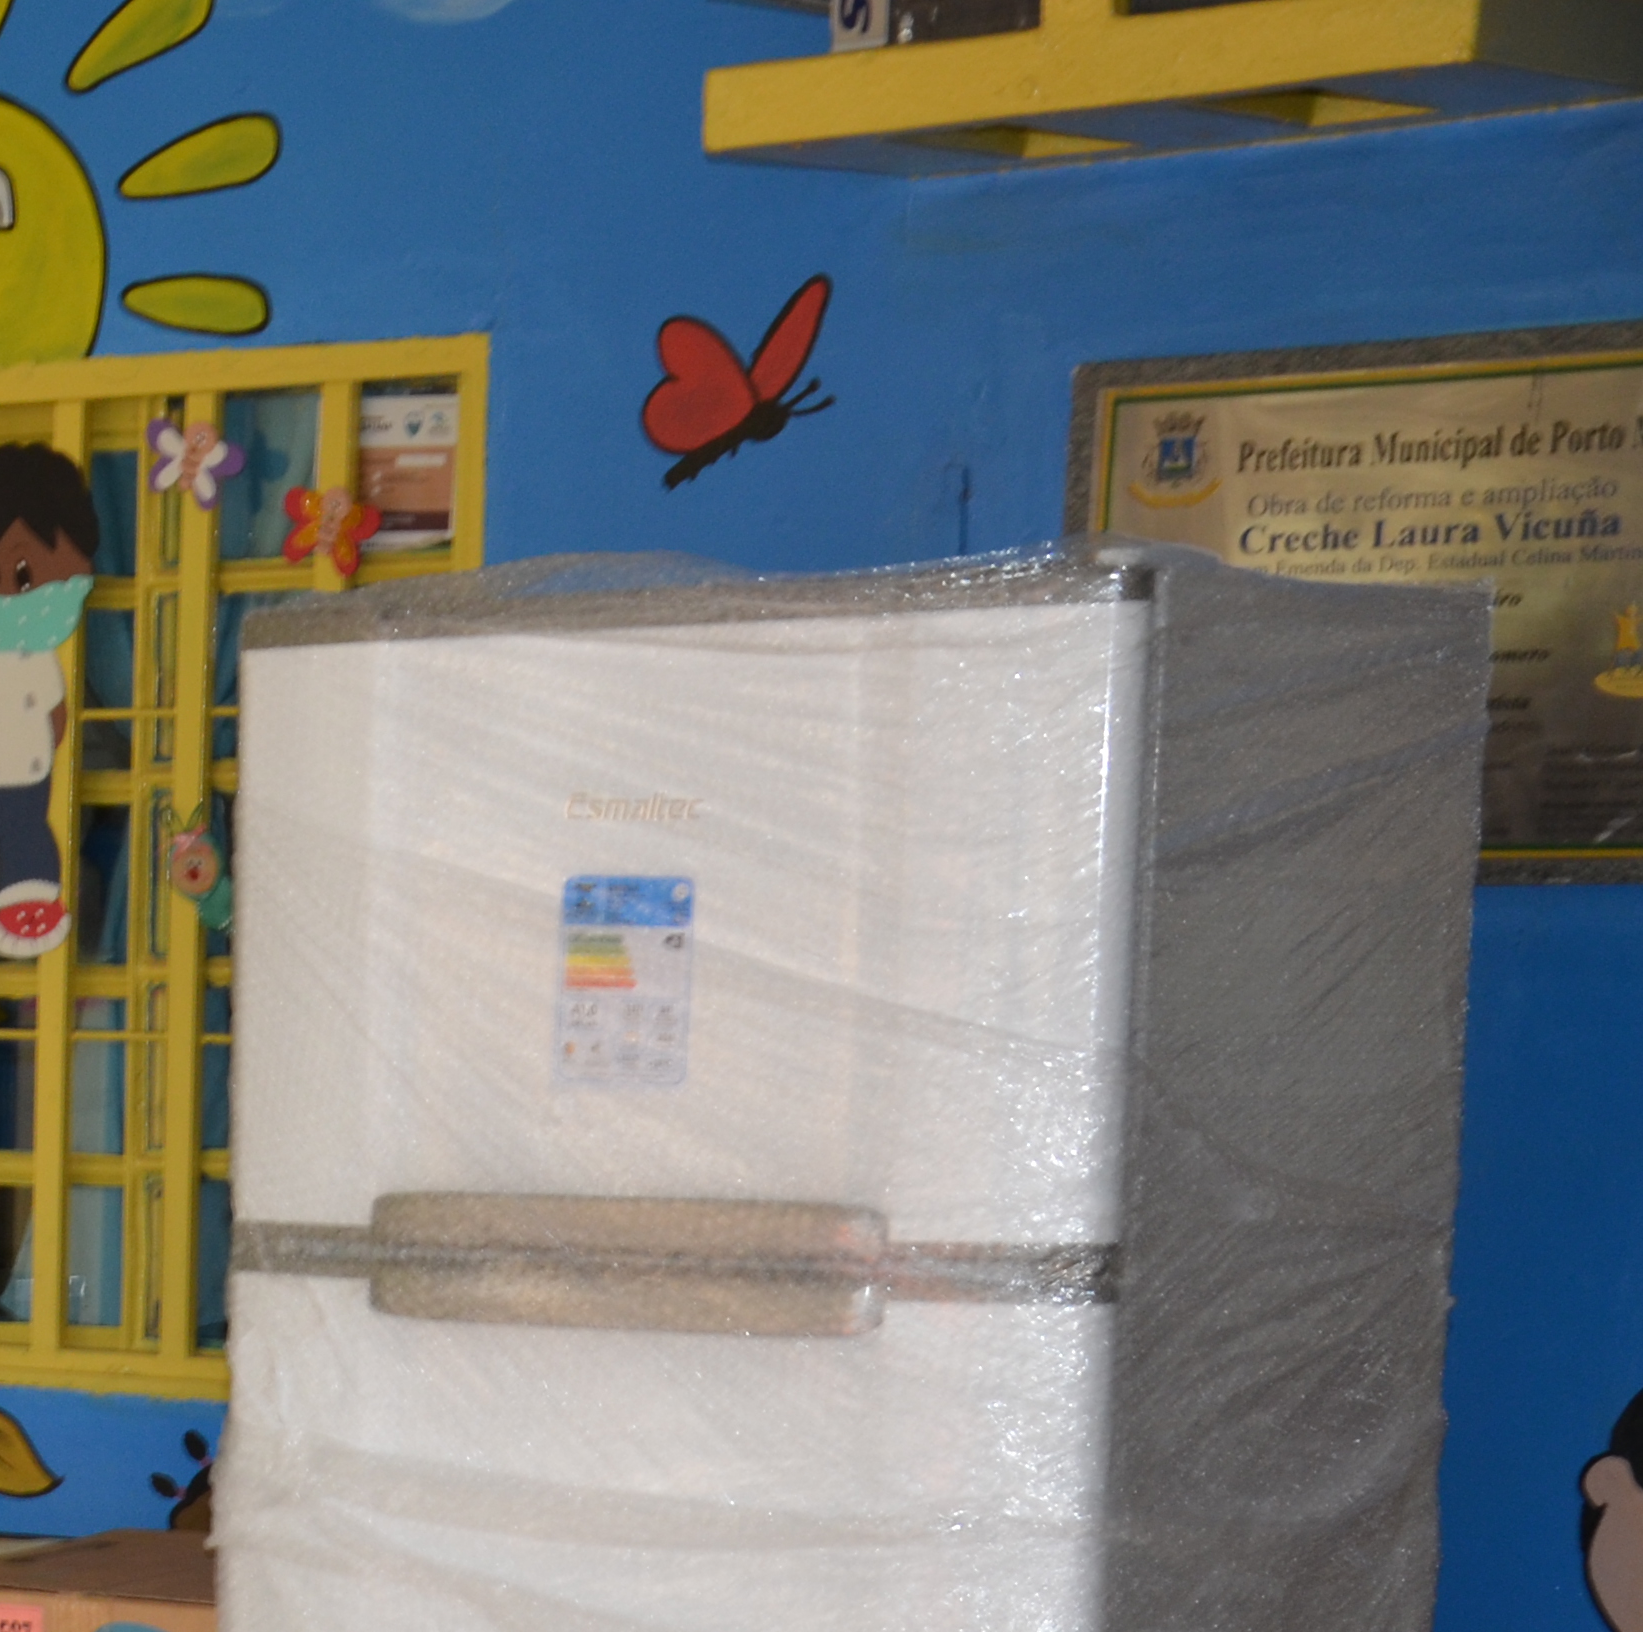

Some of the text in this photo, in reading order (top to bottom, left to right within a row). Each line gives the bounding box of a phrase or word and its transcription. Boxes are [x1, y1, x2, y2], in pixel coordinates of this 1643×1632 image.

[1237, 437, 1362, 473] Prefeitura
[1370, 425, 1504, 469] Municipal
[1509, 422, 1541, 458] de
[1550, 418, 1626, 455] Porto
[1247, 475, 1621, 518] Obra de reforma e ampliação
[1238, 507, 1623, 554] Creche Laura Vicuña
[1276, 559, 1346, 577] Emenda
[1352, 557, 1373, 573] da
[1428, 550, 1505, 571] Estadual
[565, 790, 703, 821] Esmaltec
